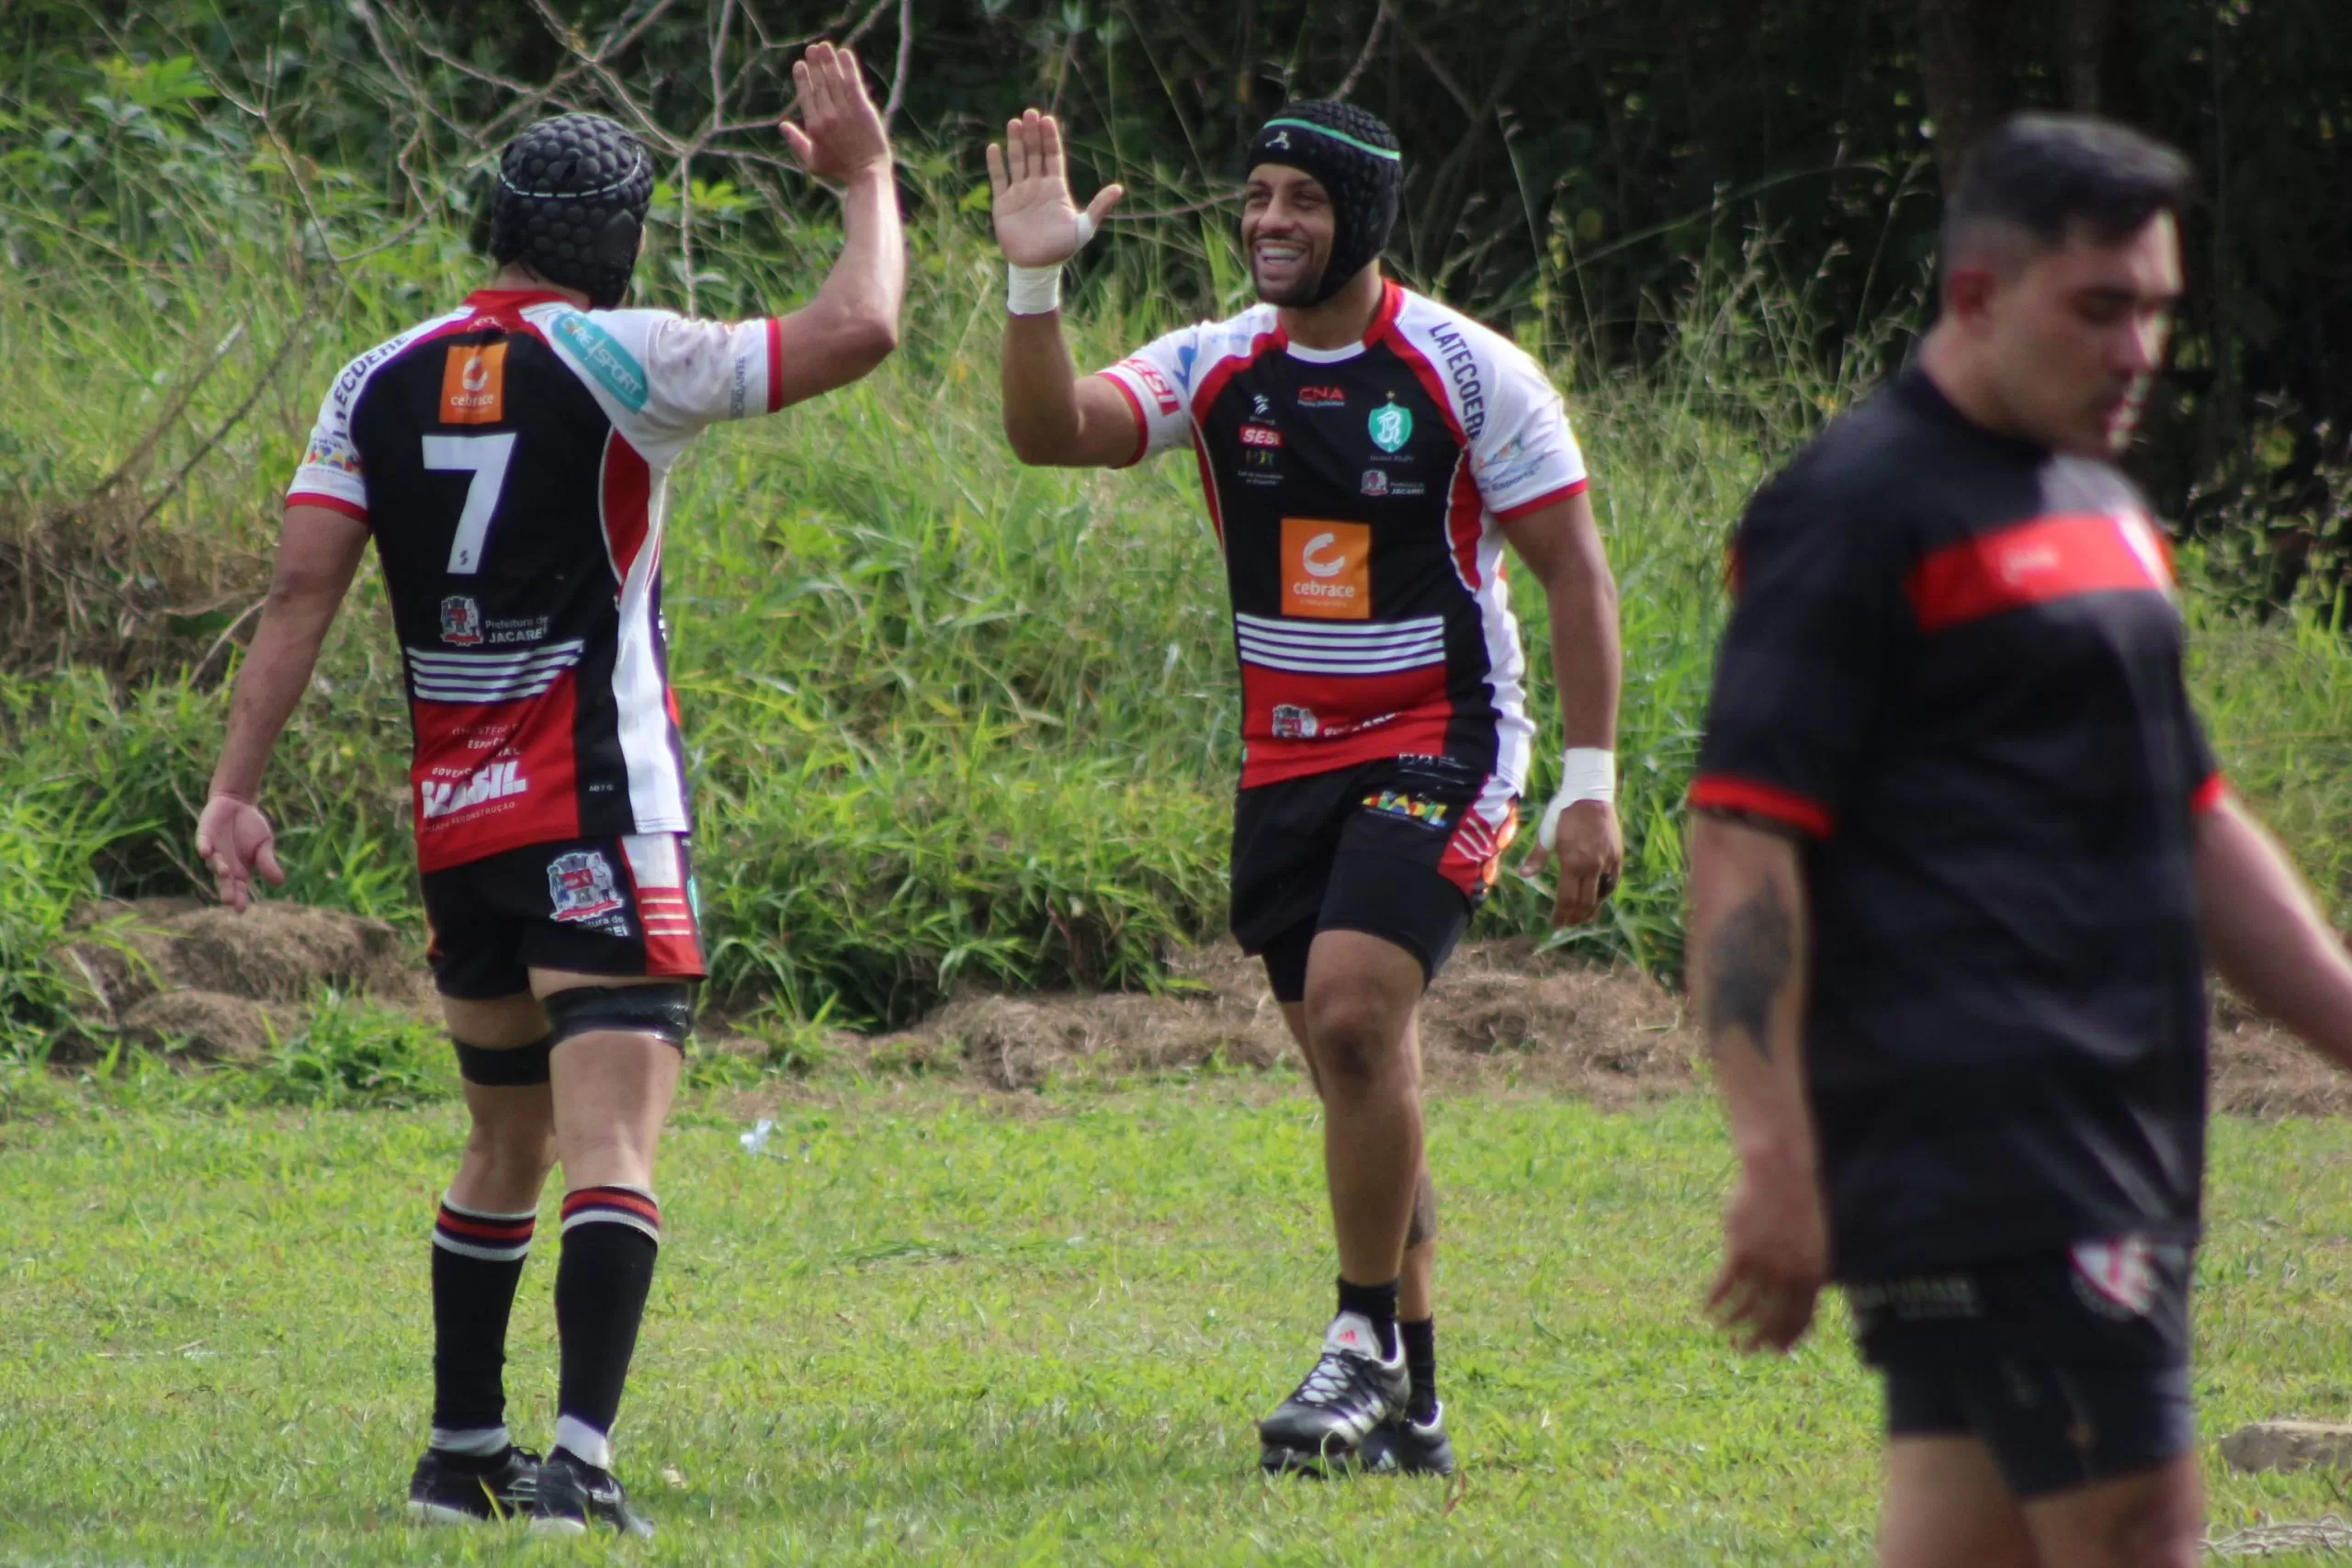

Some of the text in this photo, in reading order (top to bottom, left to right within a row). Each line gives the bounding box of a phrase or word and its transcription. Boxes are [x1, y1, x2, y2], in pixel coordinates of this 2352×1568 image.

[1298, 386, 1344, 400] CNA
[1243, 428, 1280, 446] SESI
[422, 433, 516, 574] 7
[1293, 581, 1355, 597] cebrace
